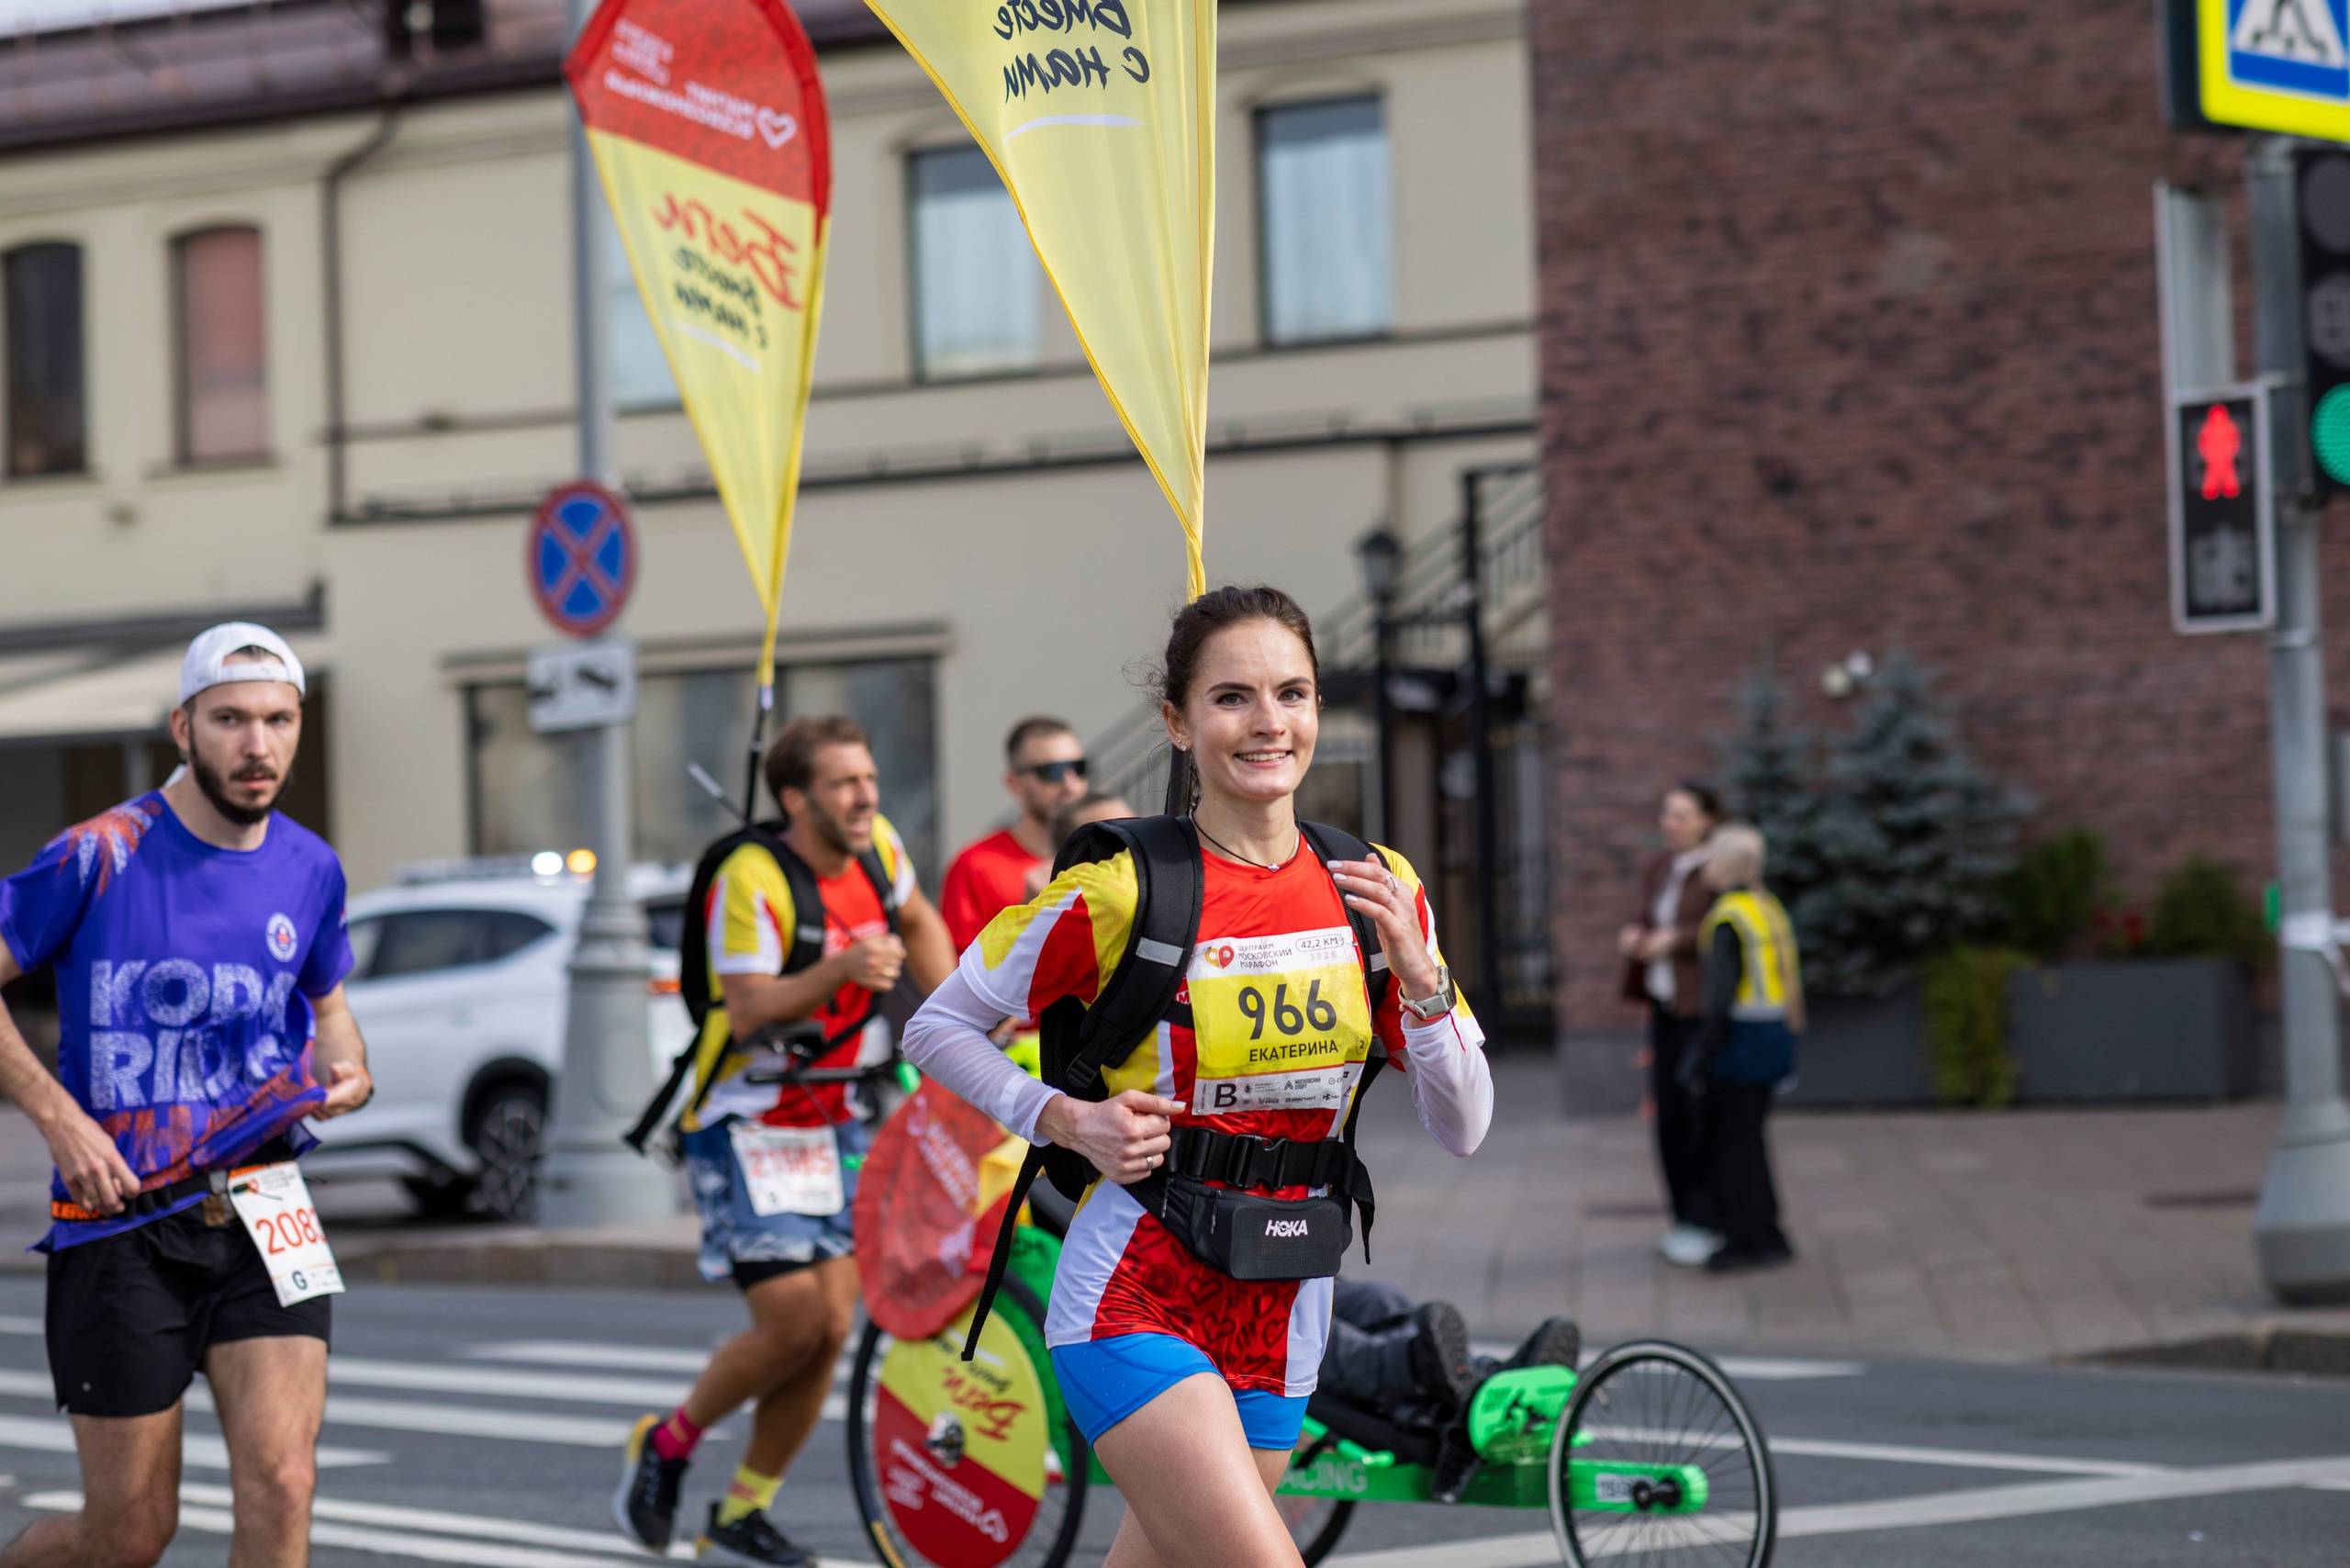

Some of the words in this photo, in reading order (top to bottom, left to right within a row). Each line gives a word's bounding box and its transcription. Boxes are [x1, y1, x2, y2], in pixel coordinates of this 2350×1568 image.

[1238, 947, 1292, 960] МОСКОВСКИЙ
[1301, 939, 1320, 948] 42,2
[1240, 959, 1279, 969] МАРАФОН
[1238, 979, 1337, 1040] 966
[1249, 1039, 1338, 1062] ЕКАТЕРИНА
[1265, 1219, 1308, 1238] HOKA
[292, 1270, 308, 1291] G
[1277, 1461, 1368, 1494] ACING
